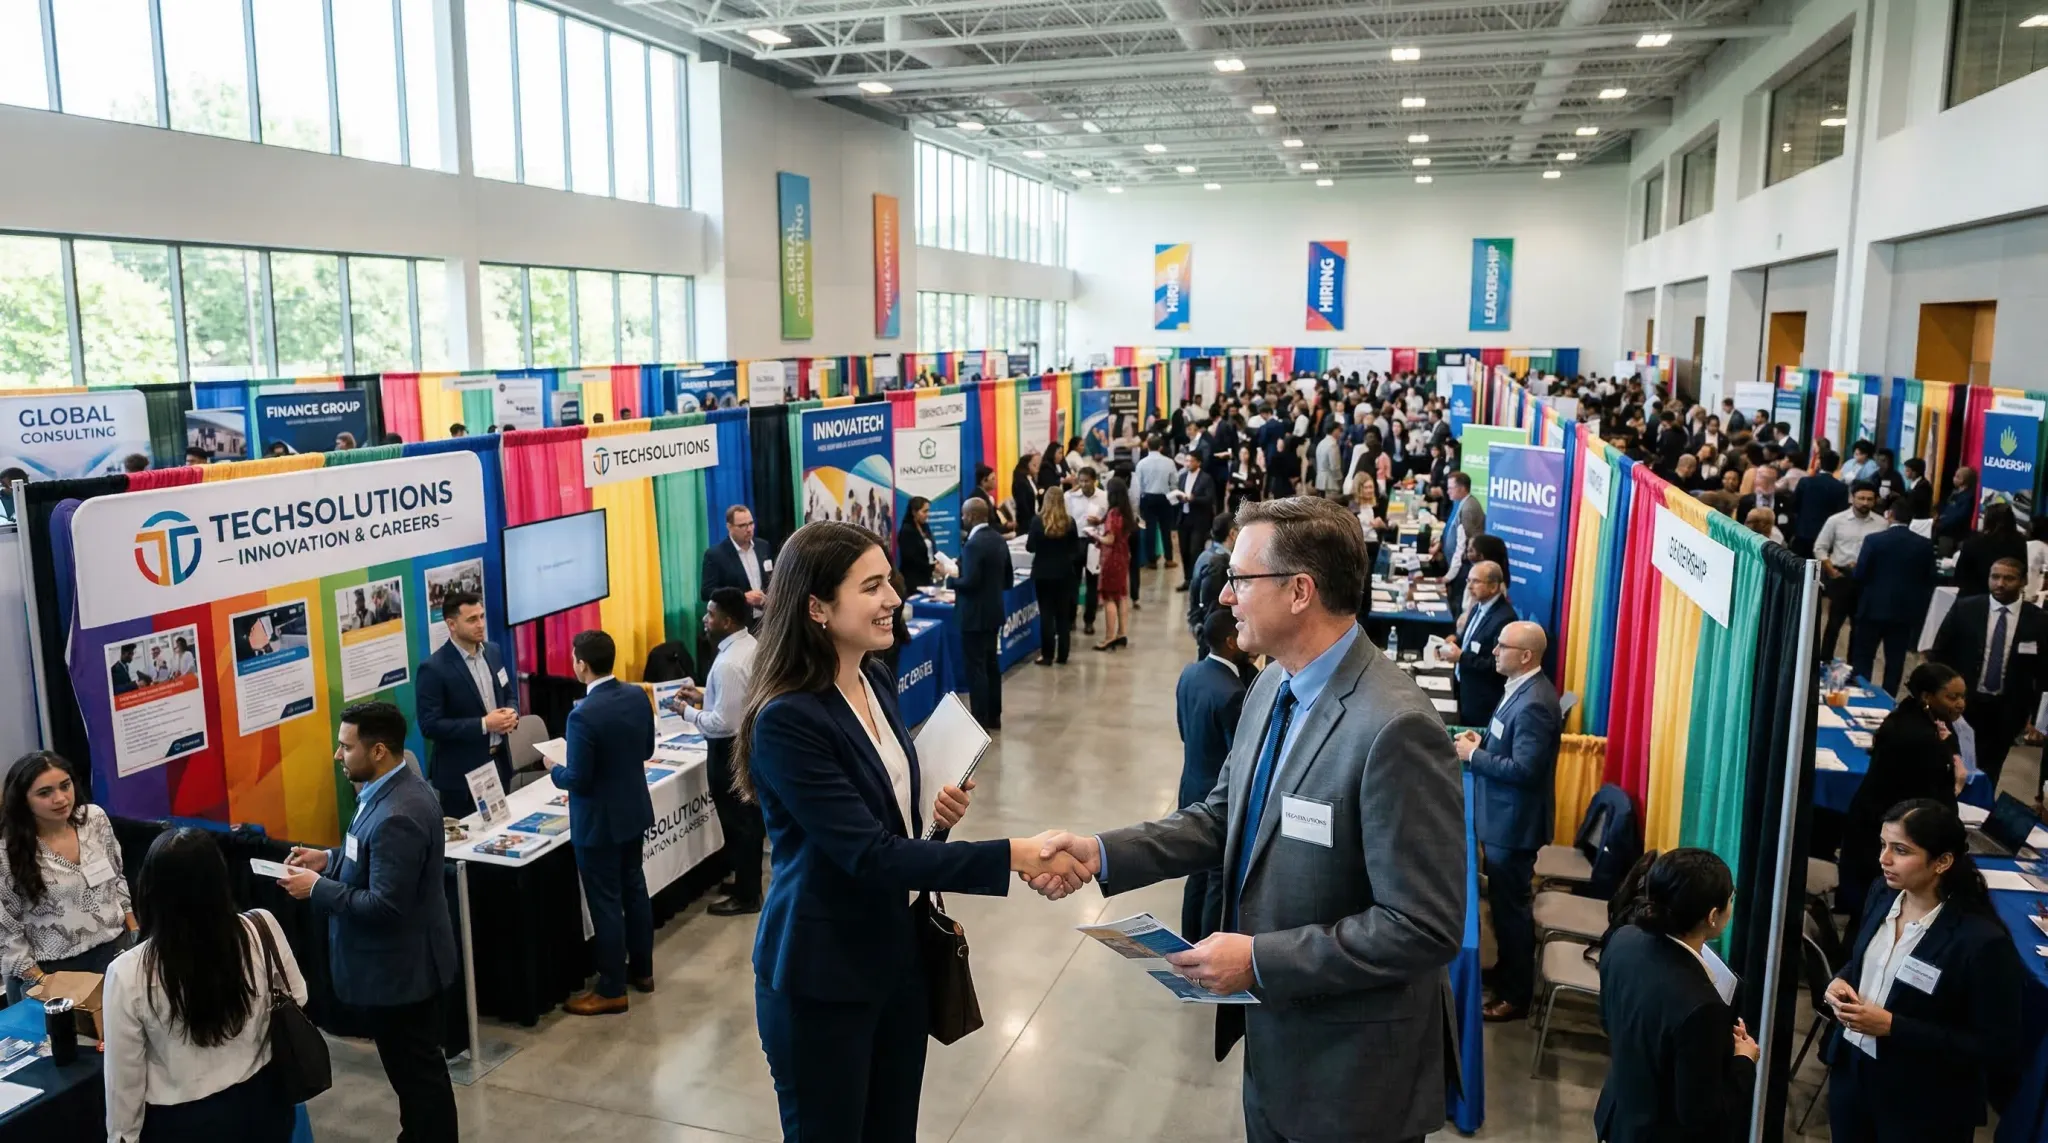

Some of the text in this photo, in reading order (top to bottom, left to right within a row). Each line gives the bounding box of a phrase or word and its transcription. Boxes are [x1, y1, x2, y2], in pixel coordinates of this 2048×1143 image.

[787, 223, 796, 295] GLOBAL
[795, 204, 805, 318] CONSULTING
[1319, 258, 1335, 312] HIRING
[1484, 244, 1499, 324] LEADERSHIP
[19, 405, 115, 427] GLOBAL
[266, 400, 360, 418] FINANCE GROUP
[20, 426, 116, 444] CONSULTING
[812, 414, 885, 441] INNOVATECH
[613, 438, 710, 466] TECHSOLUTIONS
[900, 463, 956, 475] INNOVATECH
[1489, 476, 1557, 508] HIRING
[209, 480, 454, 543] TECHSOLUTIONS
[238, 513, 440, 565] INNOVATION & CAREERS
